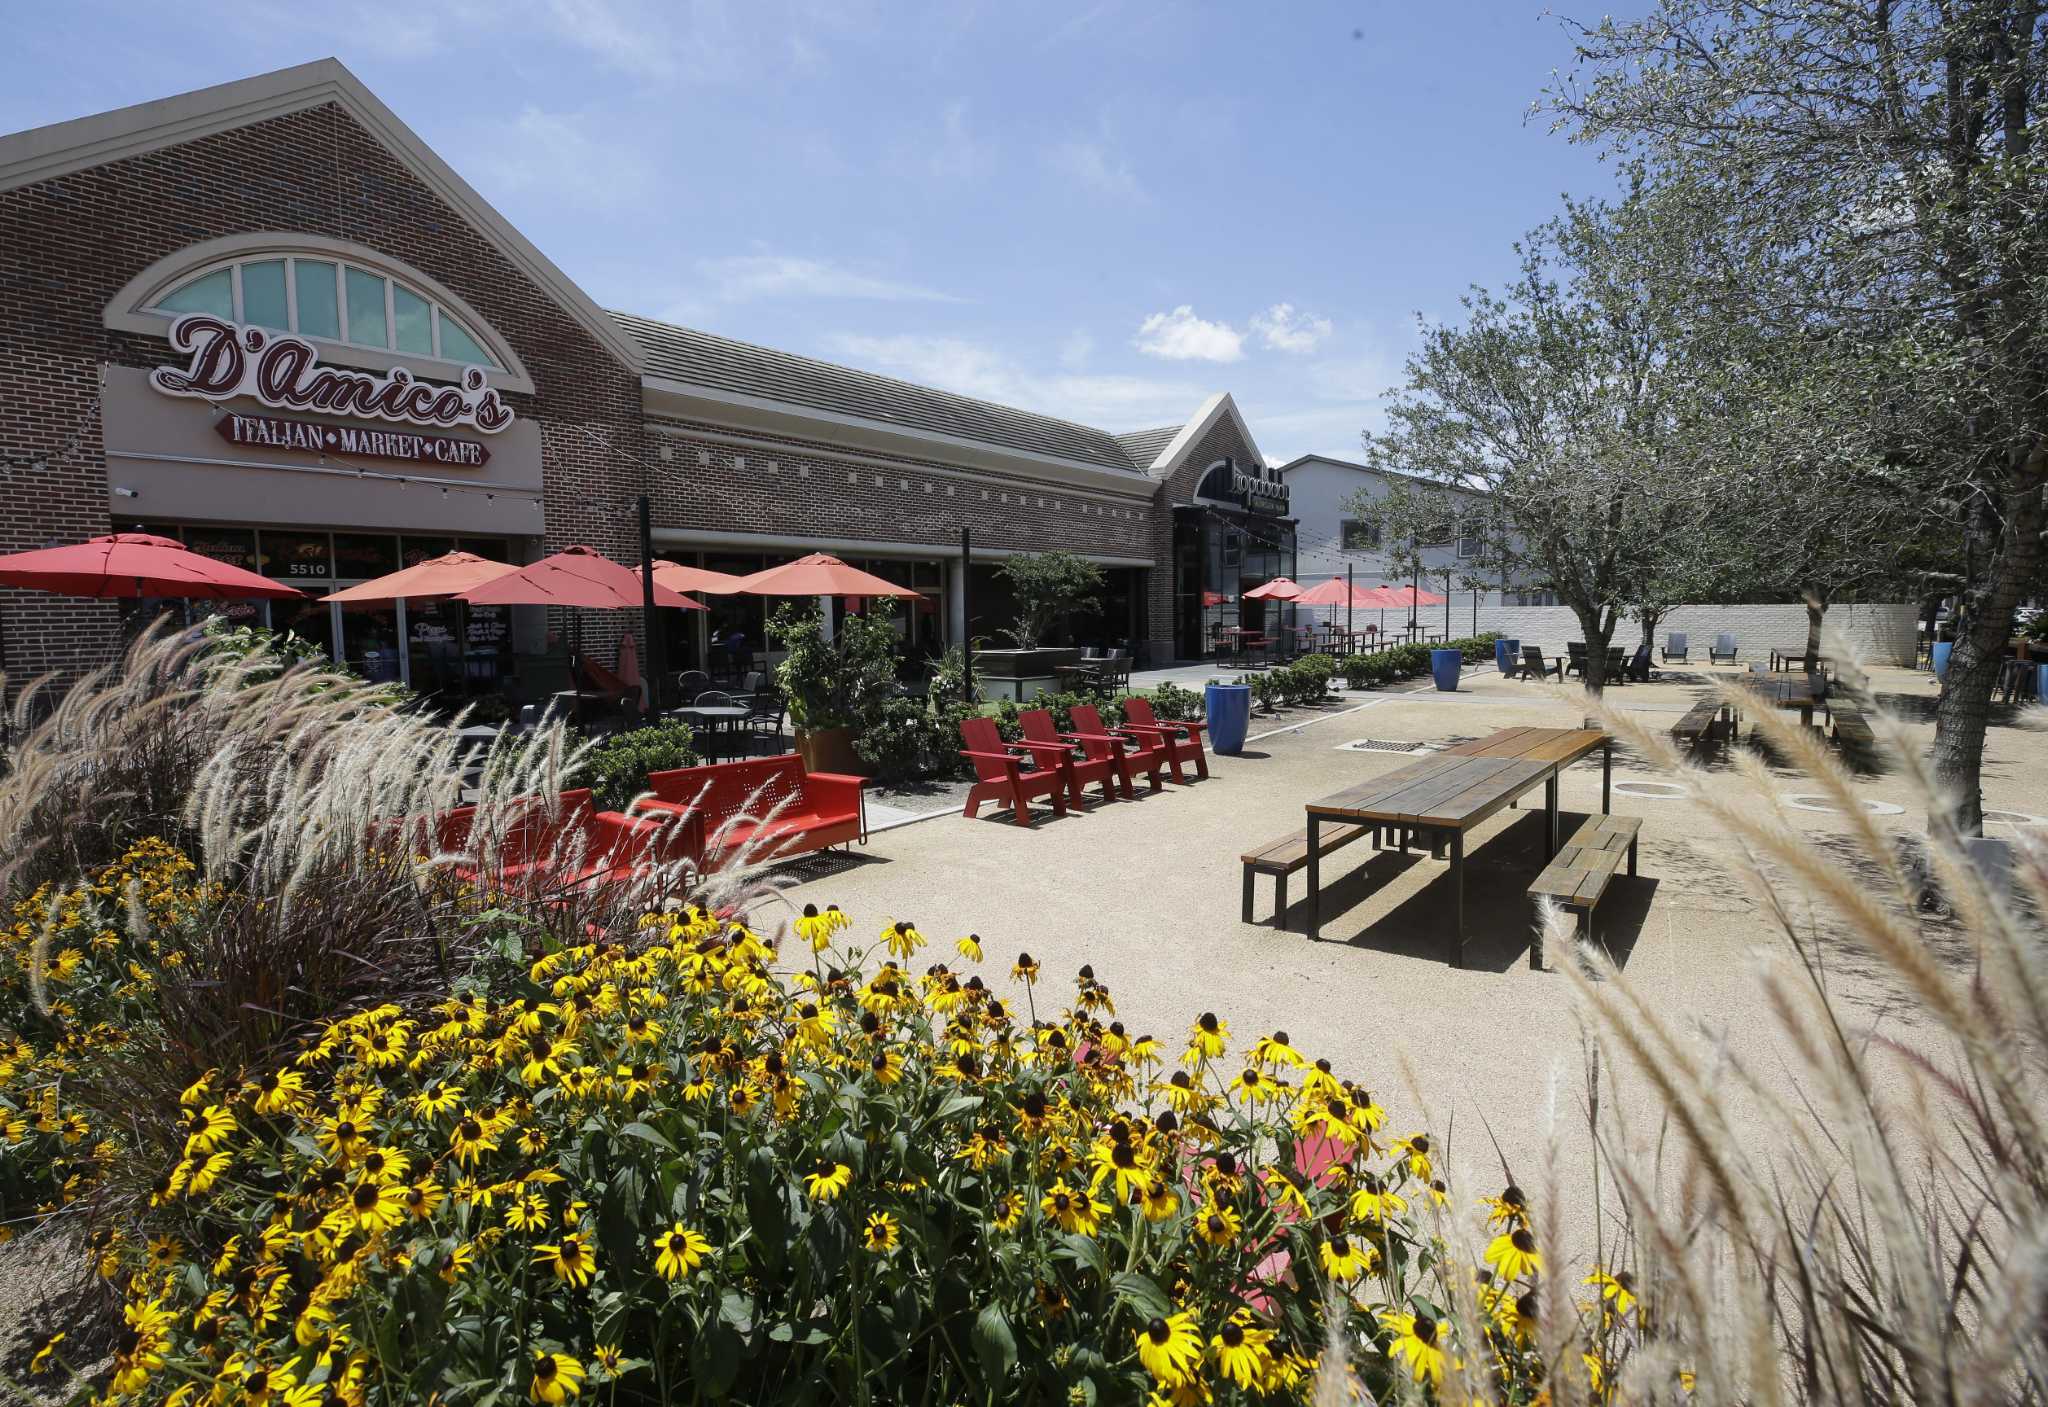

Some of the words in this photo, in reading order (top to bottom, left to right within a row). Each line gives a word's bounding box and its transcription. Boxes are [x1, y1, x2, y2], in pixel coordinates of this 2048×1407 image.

[151, 314, 514, 433] D'Amico's
[232, 416, 323, 449] ITALIAN
[340, 428, 424, 459] MARKET
[435, 439, 482, 466] CAFE
[290, 564, 325, 575] 5510
